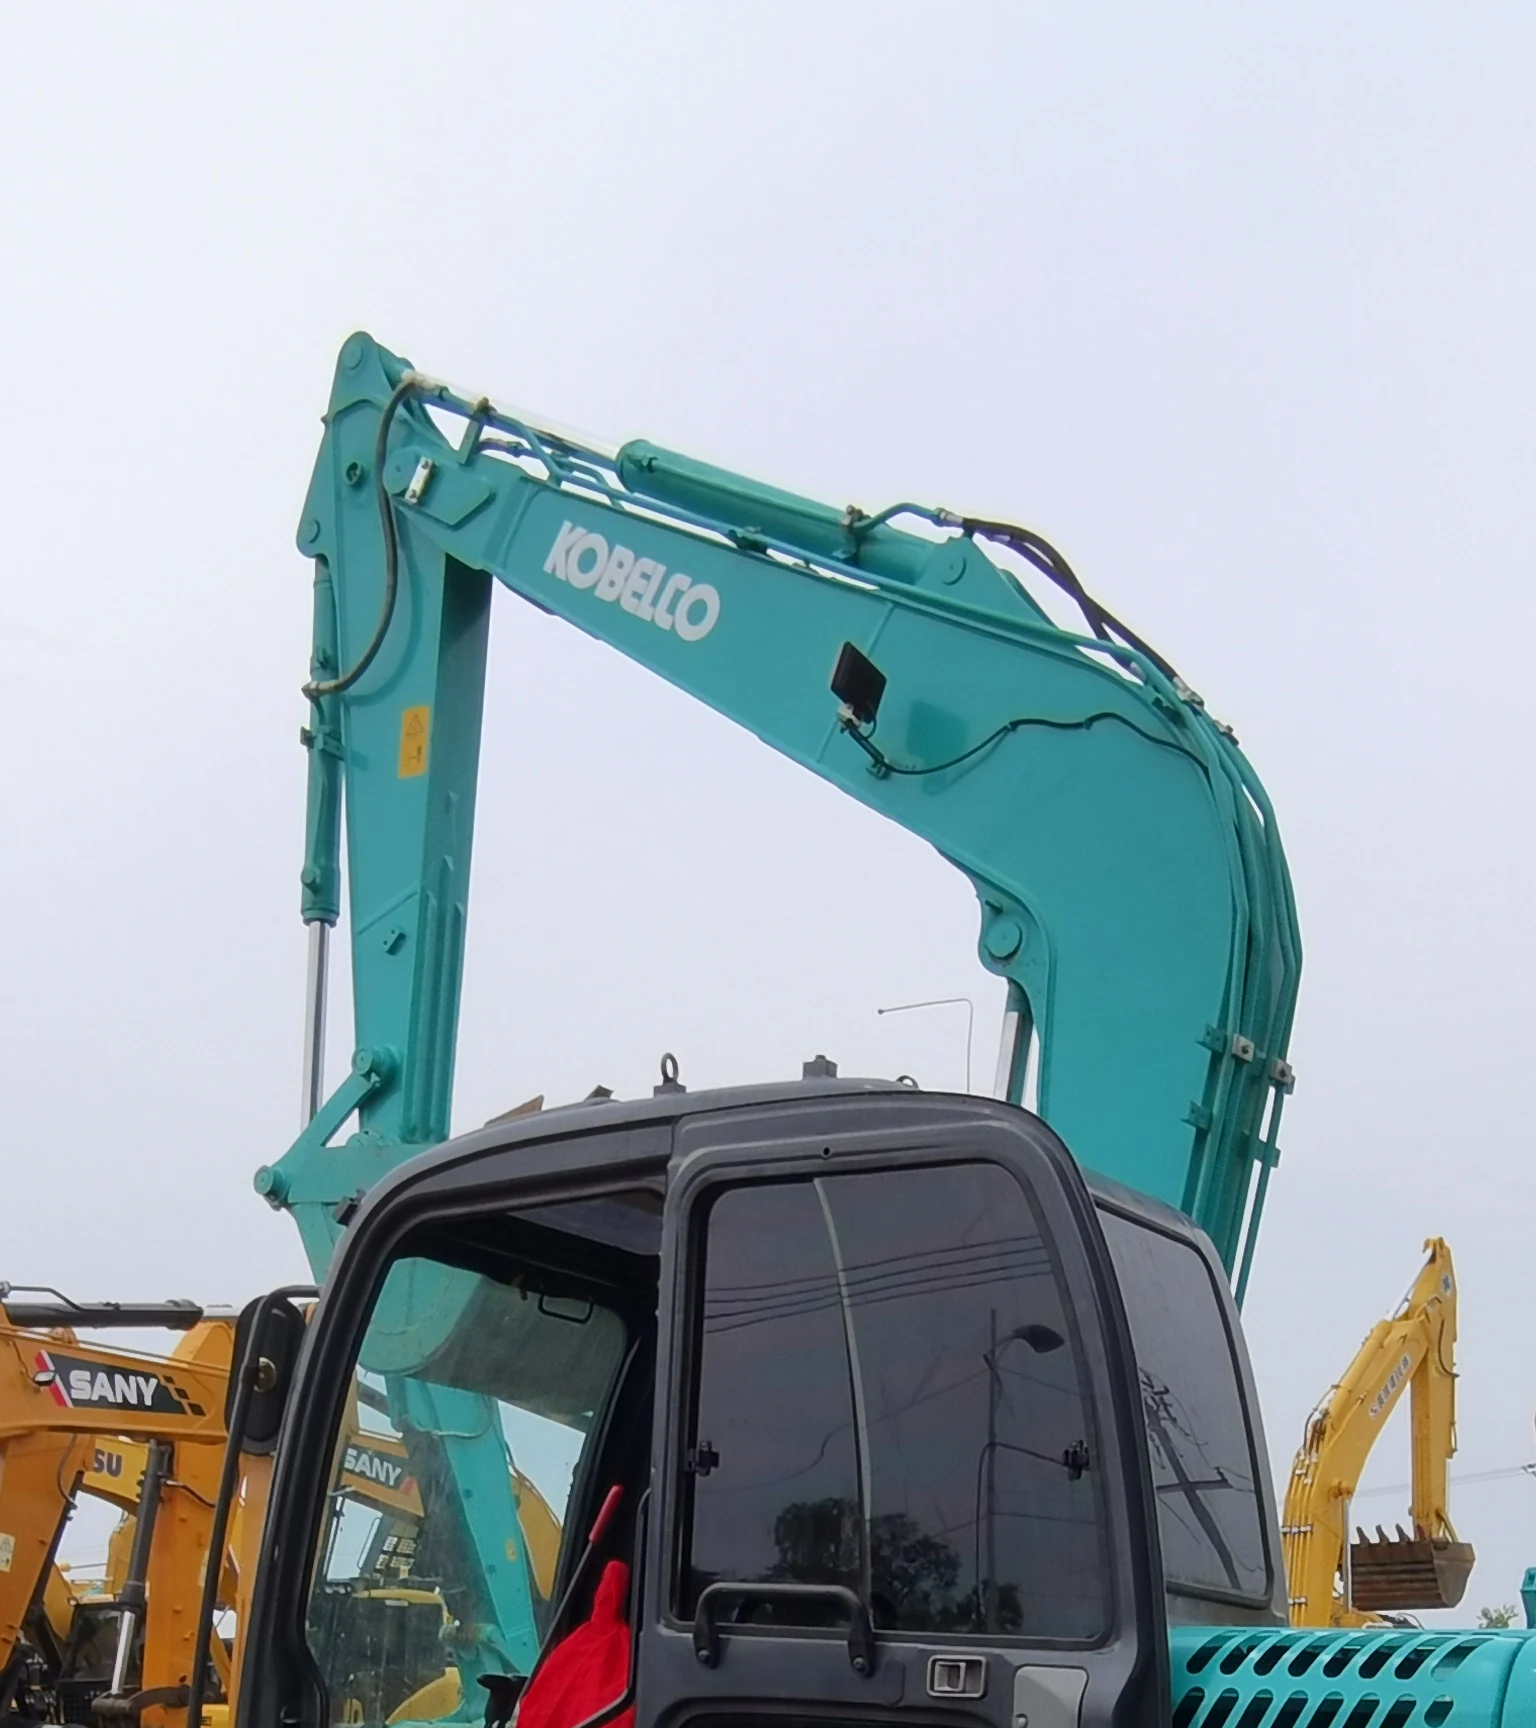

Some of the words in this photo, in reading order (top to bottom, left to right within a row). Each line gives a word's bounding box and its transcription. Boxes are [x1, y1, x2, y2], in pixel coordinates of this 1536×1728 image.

[543, 520, 720, 641] KOBELCO
[69, 1369, 158, 1406] SANY
[344, 1448, 402, 1486] SANY
